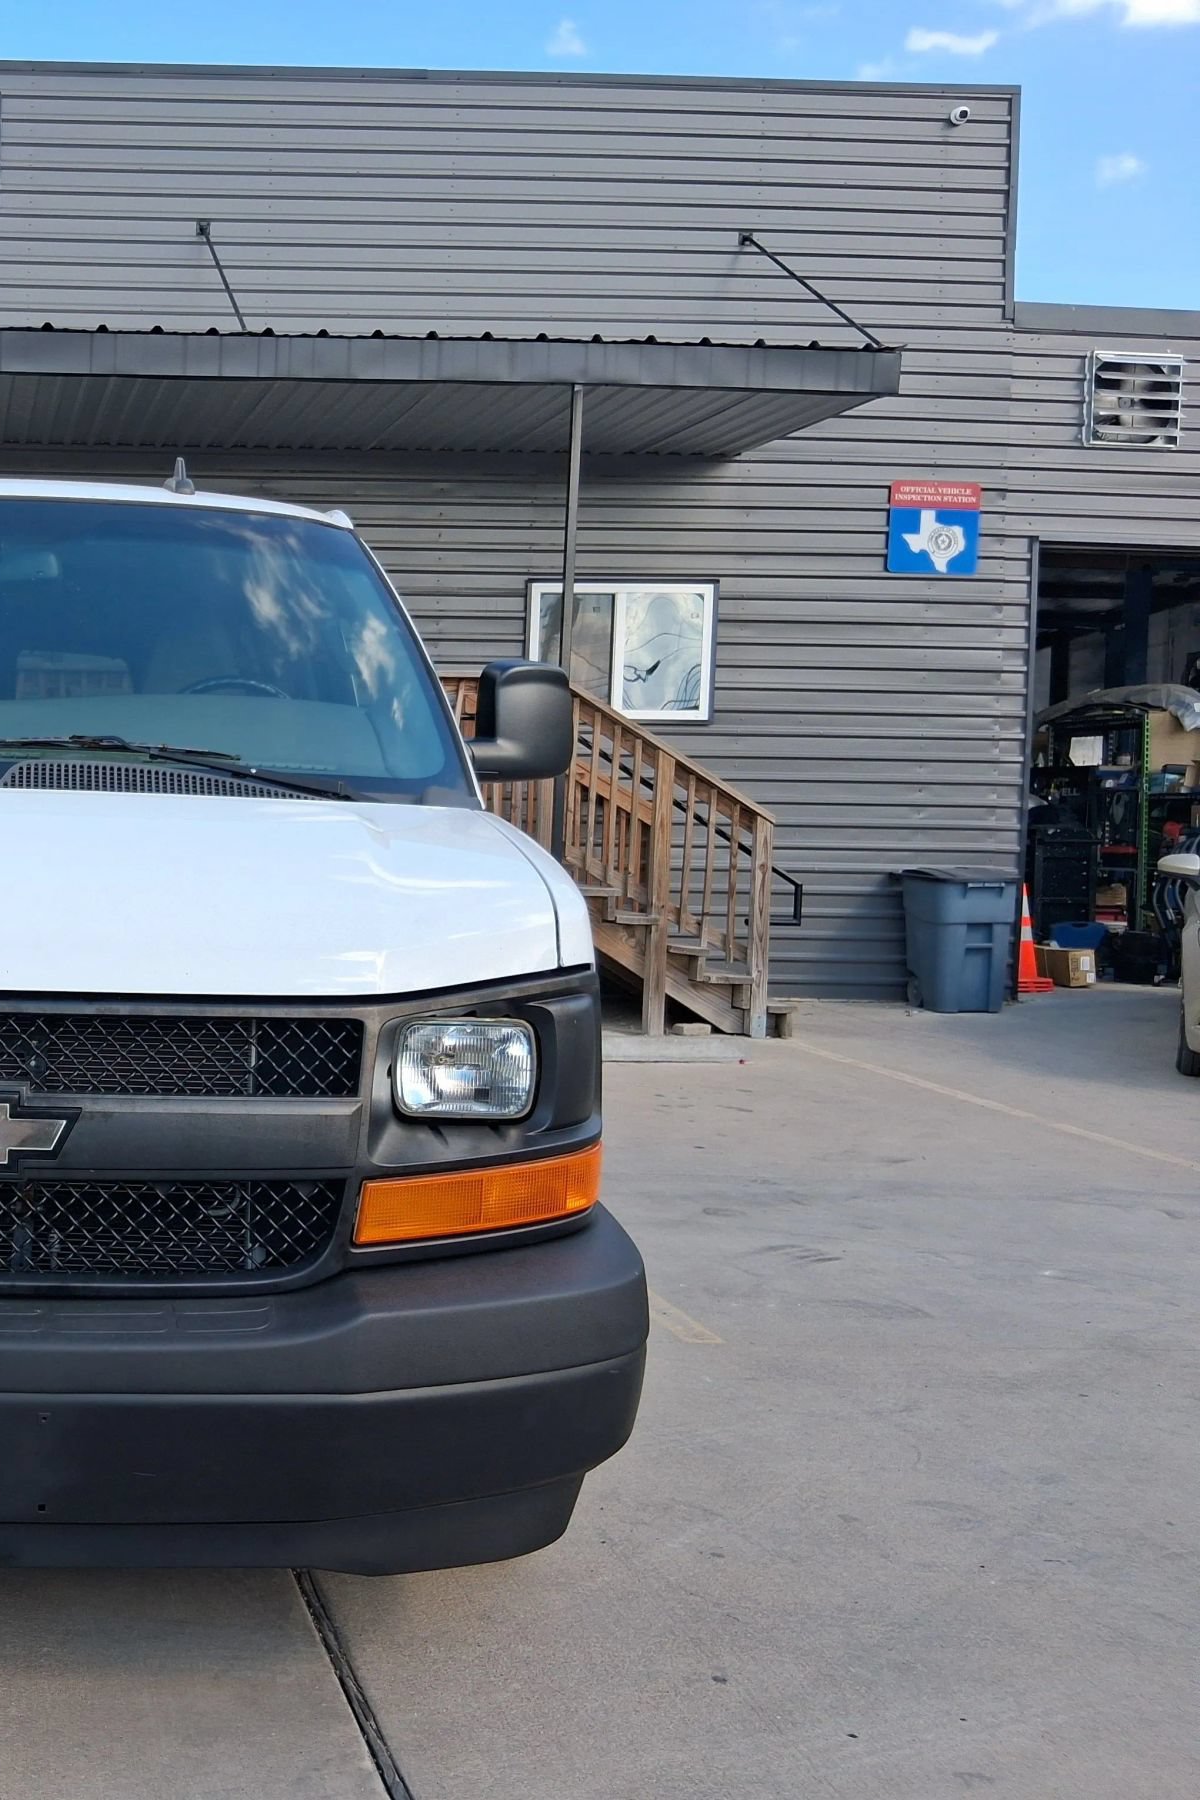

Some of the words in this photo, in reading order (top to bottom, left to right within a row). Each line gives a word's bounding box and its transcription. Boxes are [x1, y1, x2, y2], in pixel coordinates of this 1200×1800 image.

[900, 486, 936, 494] OFFICIAL
[895, 493, 942, 502] INSPECTION
[942, 495, 977, 503] STATION
